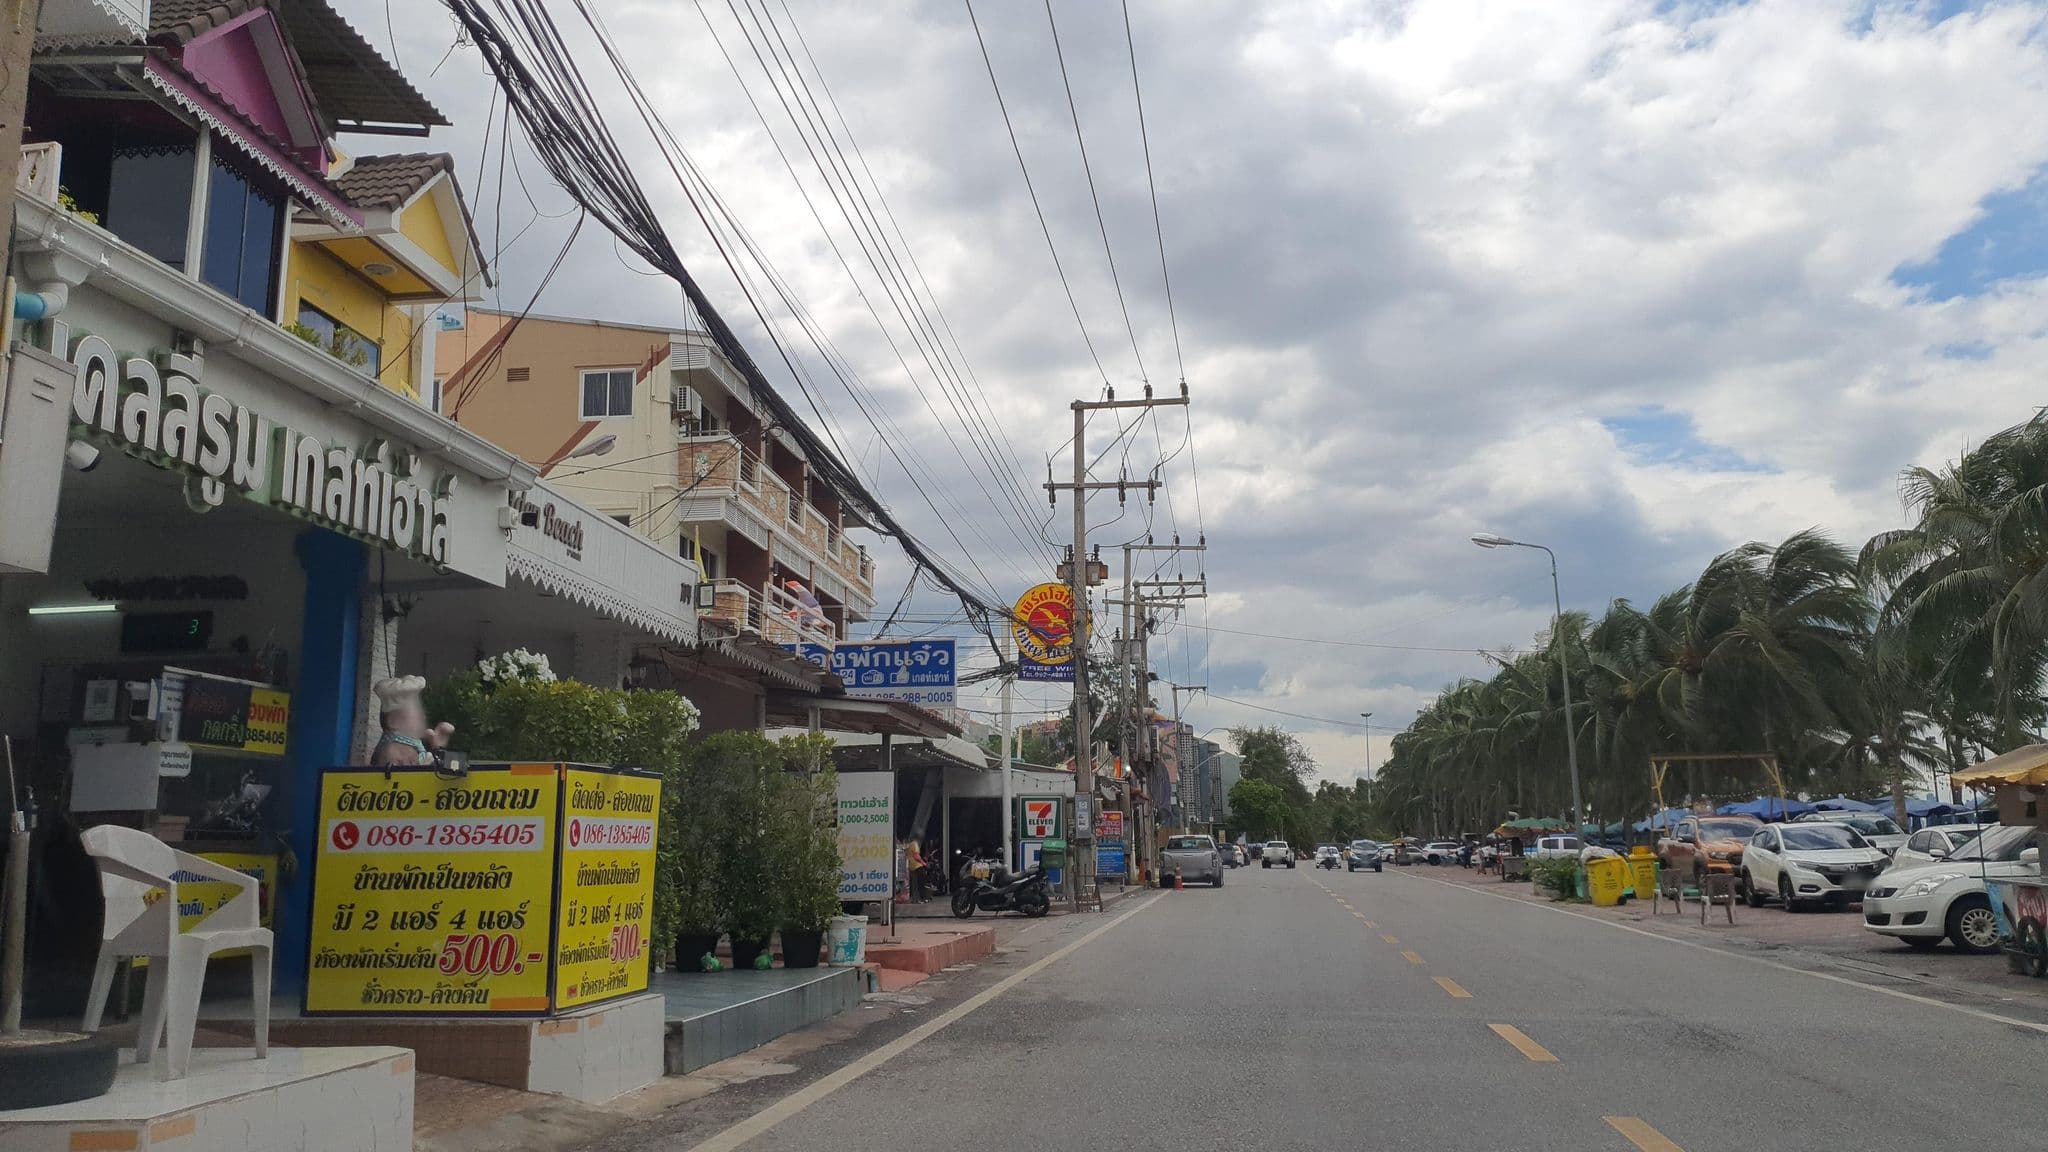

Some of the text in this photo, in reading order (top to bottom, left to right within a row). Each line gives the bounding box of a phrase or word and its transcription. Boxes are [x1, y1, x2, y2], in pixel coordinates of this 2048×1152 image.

[282, 427, 458, 564] เกสท์เฮ้าส์
[544, 502, 584, 551] Beach
[337, 781, 414, 811] ติดต่อ
[435, 788, 539, 811] สอบถาม
[572, 781, 604, 812] ติดต่อ
[612, 789, 653, 813] สอบถาม
[367, 824, 537, 847] 086-1385405
[583, 823, 651, 845] 086-1385405
[1028, 803, 1052, 837] 7
[354, 862, 513, 890] บ้านพักเป็นหลัง
[577, 859, 640, 887] บ้านพักเป็นหลัง
[859, 872, 864, 880] 1
[866, 870, 889, 880] เตียง
[332, 900, 530, 931] มี 2 แอร์ 4 แอร์
[567, 893, 647, 928] มี 2 แอร์ 4 แอร์
[314, 933, 544, 975] ห้องพักเริ่มต้น 500.-
[559, 936, 610, 967] ห้องพักเริ่มต้น
[361, 978, 490, 1005] ชั่วคราว-ค้างคืน
